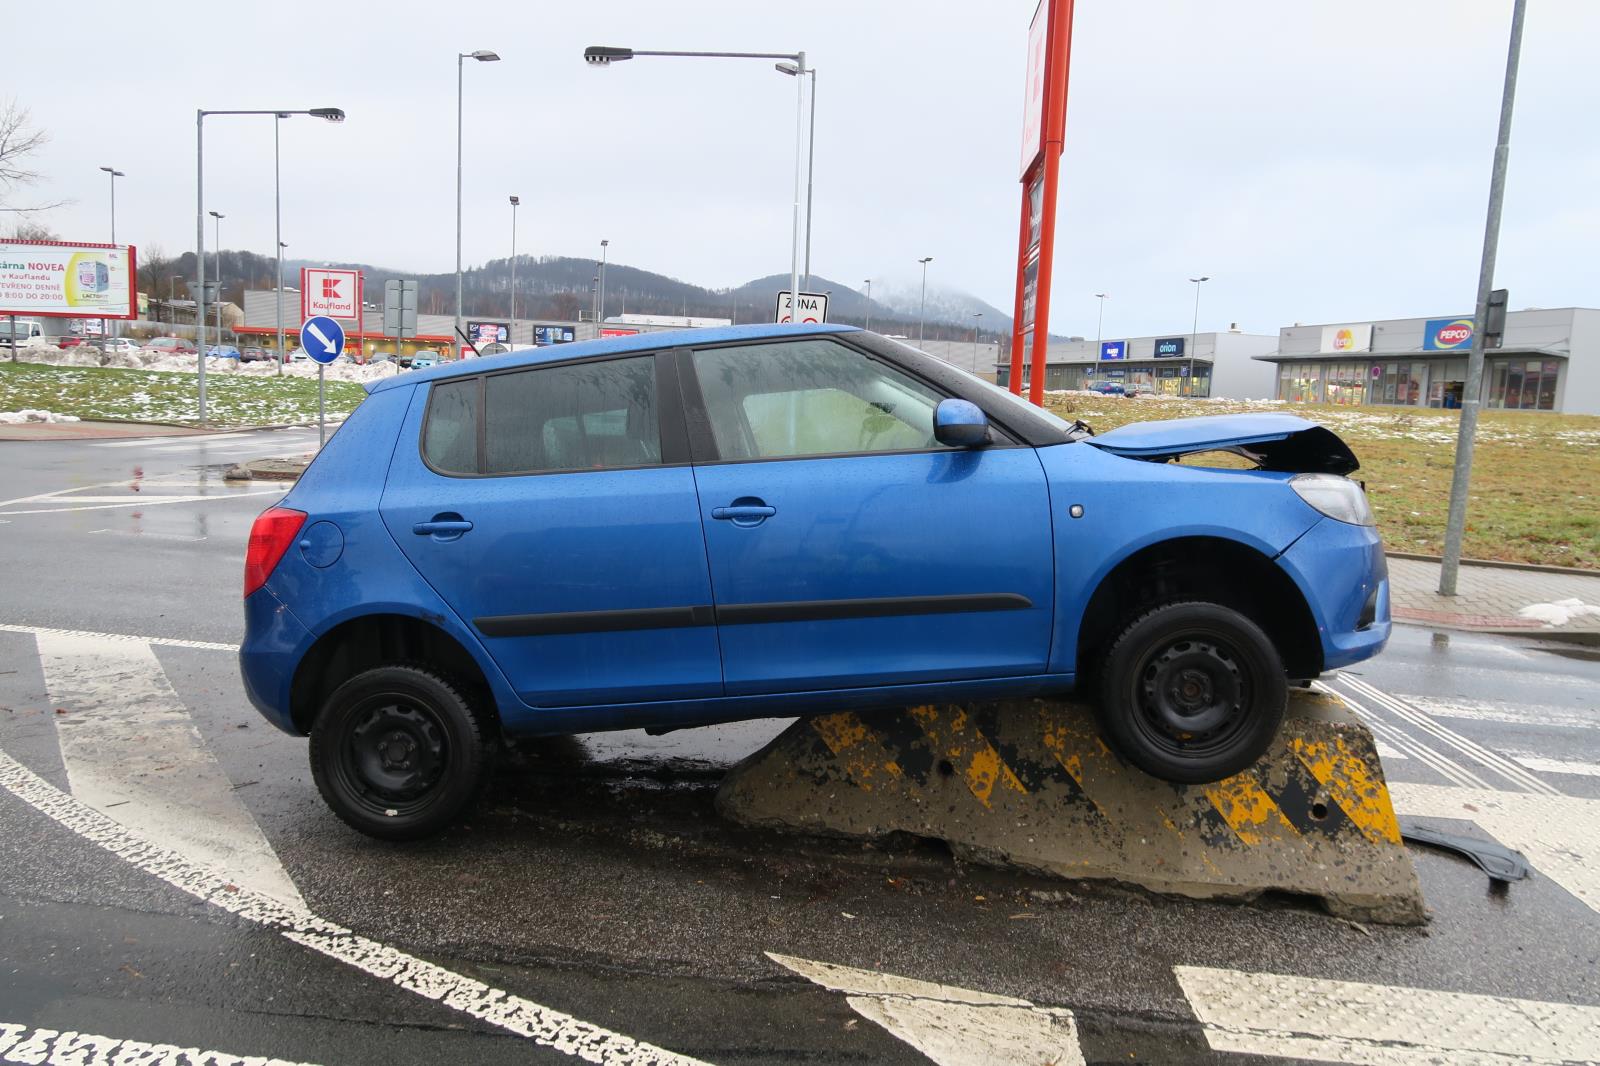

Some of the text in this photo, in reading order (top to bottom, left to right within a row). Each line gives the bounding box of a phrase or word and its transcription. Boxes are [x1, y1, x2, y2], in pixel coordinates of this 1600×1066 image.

[0, 261, 65, 272] árna NOVEA
[9, 273, 51, 281] Kauflandu
[26, 292, 38, 300] DO
[313, 301, 351, 310] Kaufland
[1439, 329, 1468, 340] PEPCO
